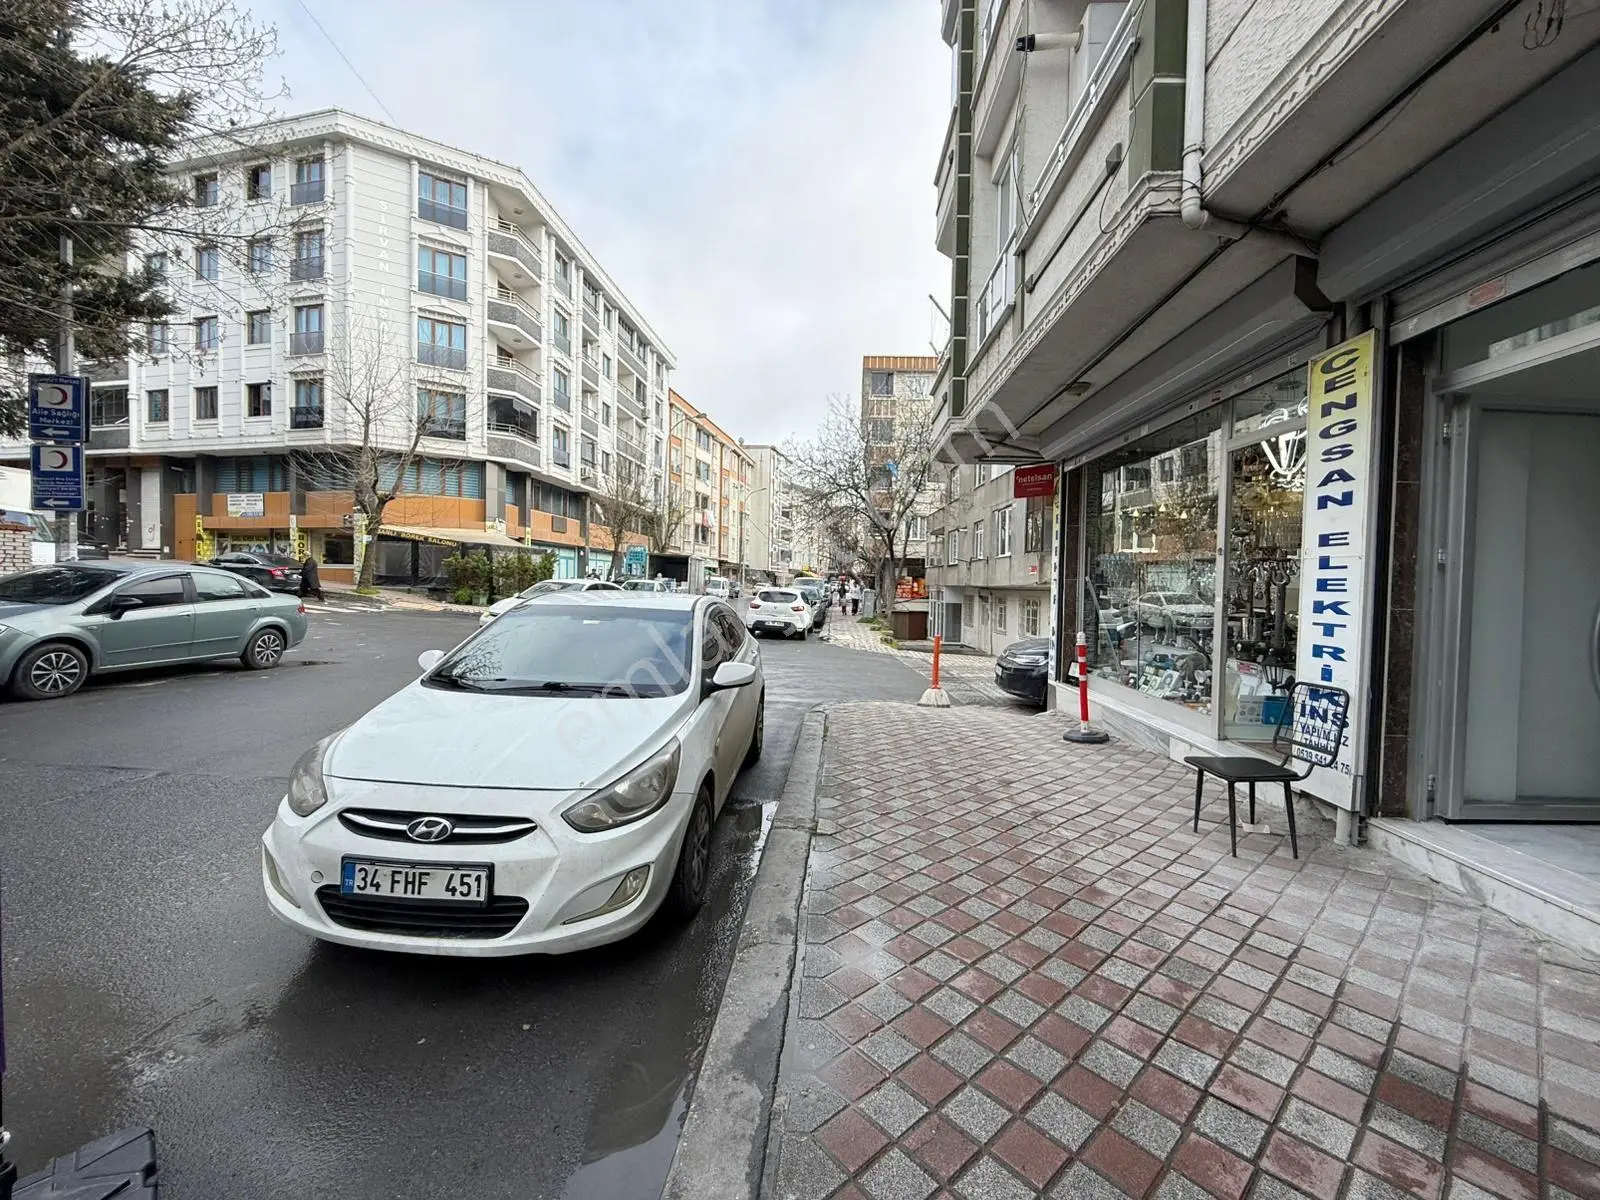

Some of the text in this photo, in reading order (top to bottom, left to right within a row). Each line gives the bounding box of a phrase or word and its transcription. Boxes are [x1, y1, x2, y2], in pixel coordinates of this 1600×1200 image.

[50, 408, 80, 419] Sağlığı
[39, 417, 74, 425] Merkezi
[1308, 347, 1361, 708] CENGSAN ELEKTRİK
[428, 536, 458, 547] SALONU
[345, 867, 482, 898] TR 34 FHF 451
